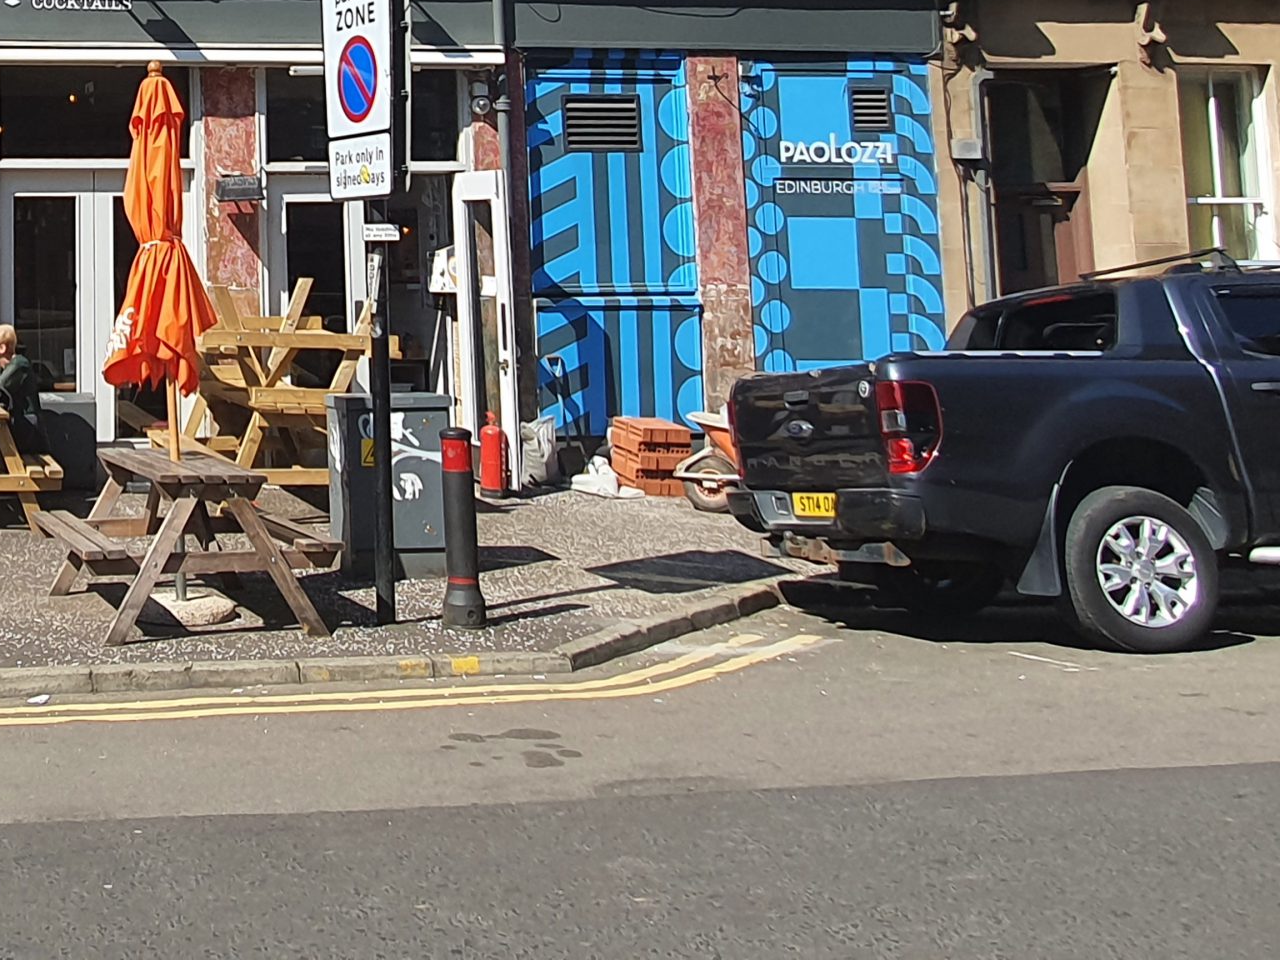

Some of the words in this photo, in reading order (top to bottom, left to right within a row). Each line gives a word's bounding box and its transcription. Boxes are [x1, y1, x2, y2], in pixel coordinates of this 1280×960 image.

[335, 1, 376, 32] ZONE
[334, 149, 354, 166] Park
[355, 146, 374, 166] only
[375, 145, 384, 161] in
[775, 180, 865, 194] EDINBURGH
[799, 495, 822, 513] ST14
